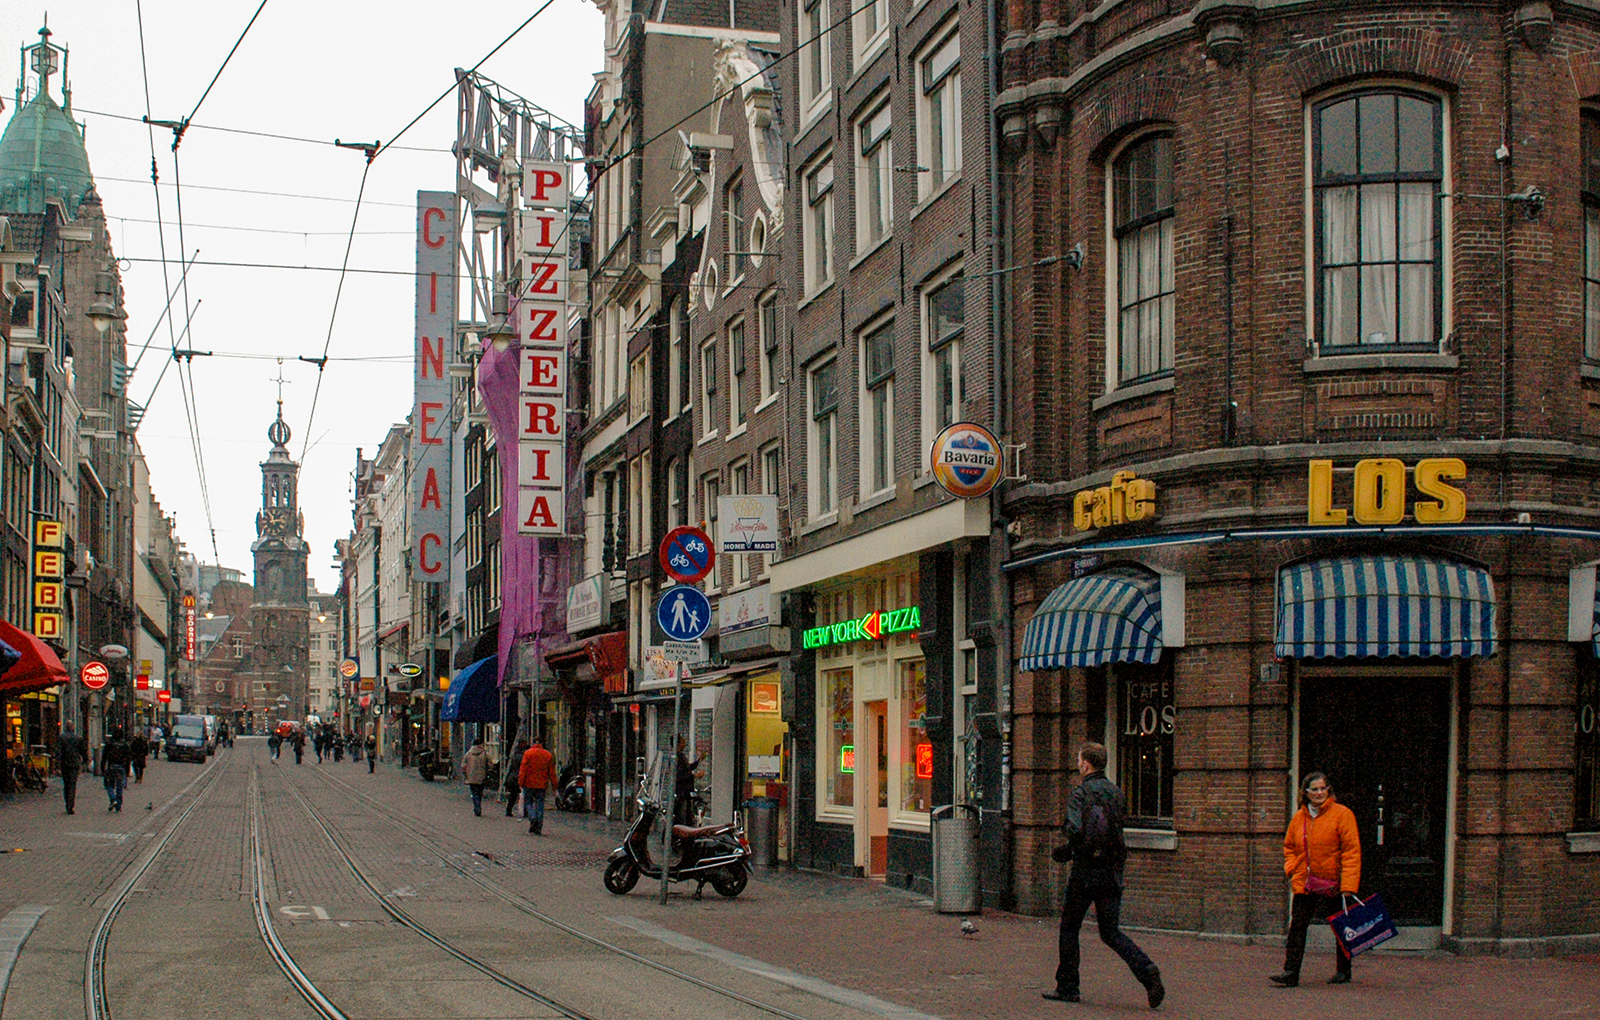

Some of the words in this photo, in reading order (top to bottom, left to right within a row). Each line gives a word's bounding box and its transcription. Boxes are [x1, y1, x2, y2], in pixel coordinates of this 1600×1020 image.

[523, 169, 561, 527] PIZZERIA
[419, 207, 447, 575] CINEAC
[944, 450, 995, 466] Bavaria
[1308, 457, 1467, 526] LOS
[40, 525, 58, 635] FEBO
[803, 627, 831, 649] NEW
[831, 612, 872, 643] YORK
[879, 606, 921, 635] PIZZA
[1124, 681, 1177, 735] LOS
